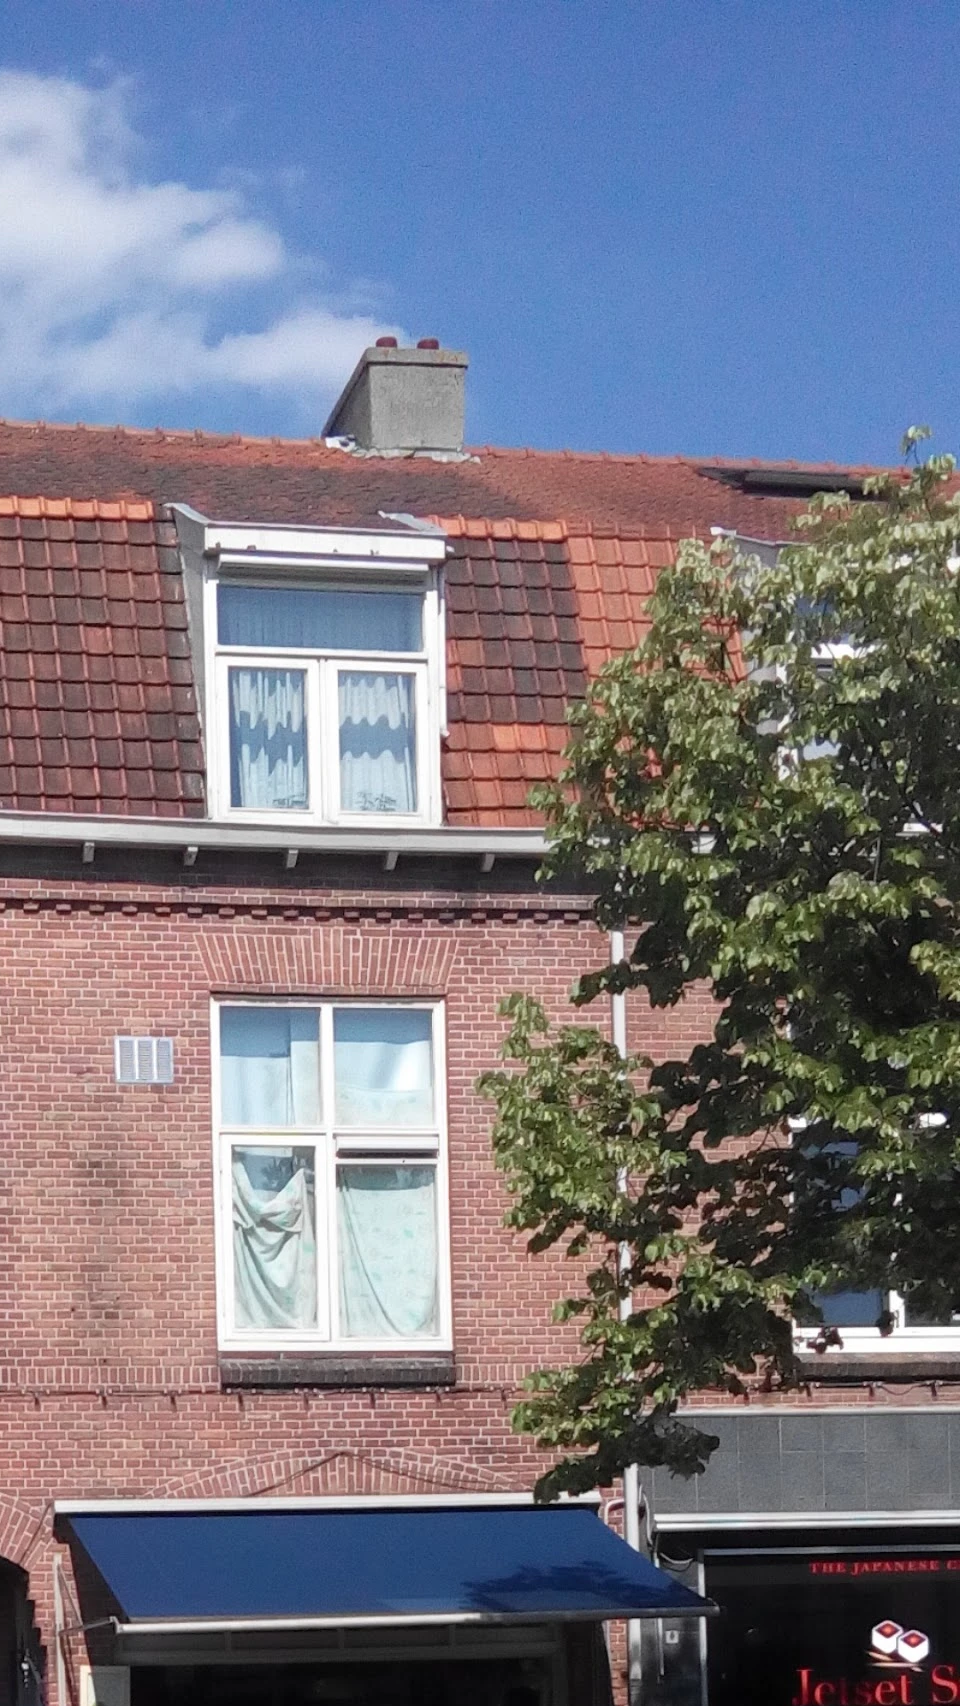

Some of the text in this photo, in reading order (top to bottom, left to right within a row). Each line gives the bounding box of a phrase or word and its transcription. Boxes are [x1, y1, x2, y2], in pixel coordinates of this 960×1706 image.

[810, 1561, 846, 1574] THE
[851, 1559, 940, 1576] JAPANESE
[792, 1664, 960, 1706] Jetset S
